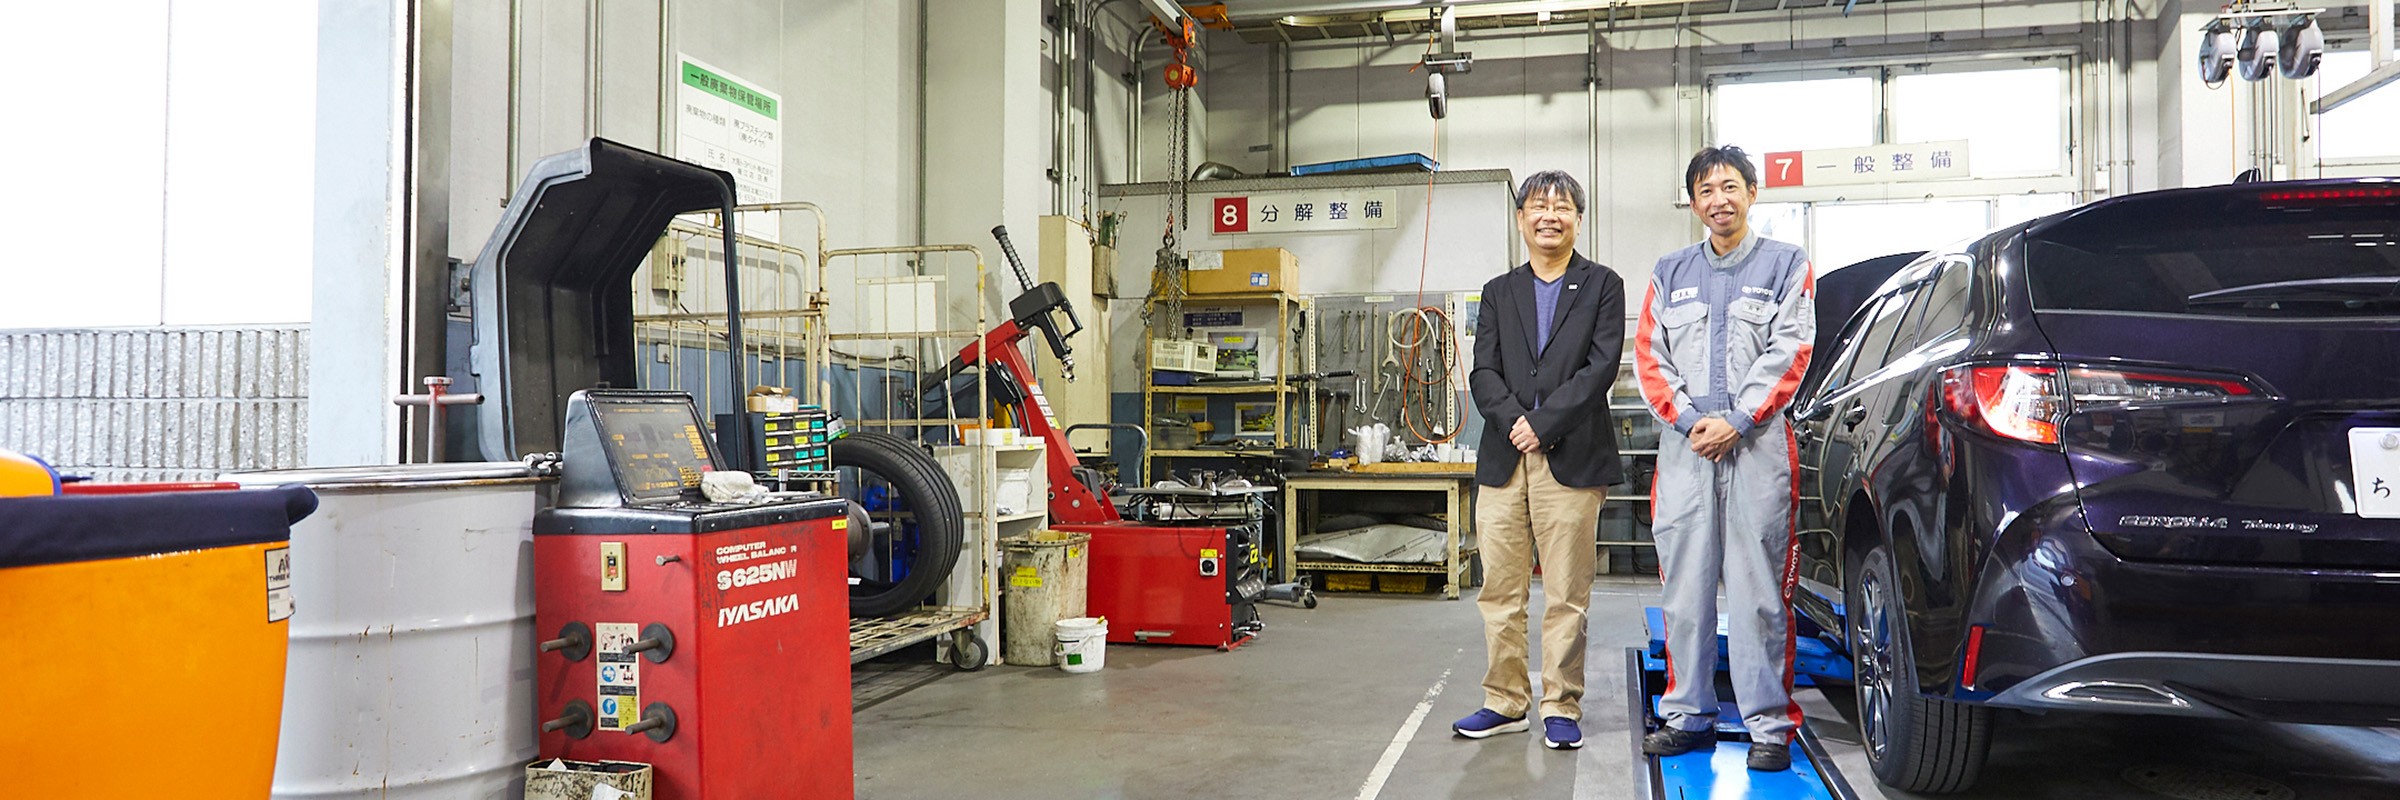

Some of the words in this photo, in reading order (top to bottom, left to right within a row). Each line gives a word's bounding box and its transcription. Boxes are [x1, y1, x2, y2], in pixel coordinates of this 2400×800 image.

[690, 73, 771, 114] 一般廃棄物保管場所
[1775, 158, 1793, 181] 7
[1816, 150, 1952, 174] 一般整備
[1221, 204, 1238, 226] 8
[1260, 200, 1383, 223] 分解整備
[2372, 477, 2390, 498] ち
[716, 541, 766, 555] COMPUTER
[716, 552, 750, 564] WHEEL
[751, 545, 797, 559] BALANCR
[717, 559, 797, 591] S625NW
[1787, 544, 1799, 584] TOYOTA
[718, 593, 799, 628] IYASAKA
